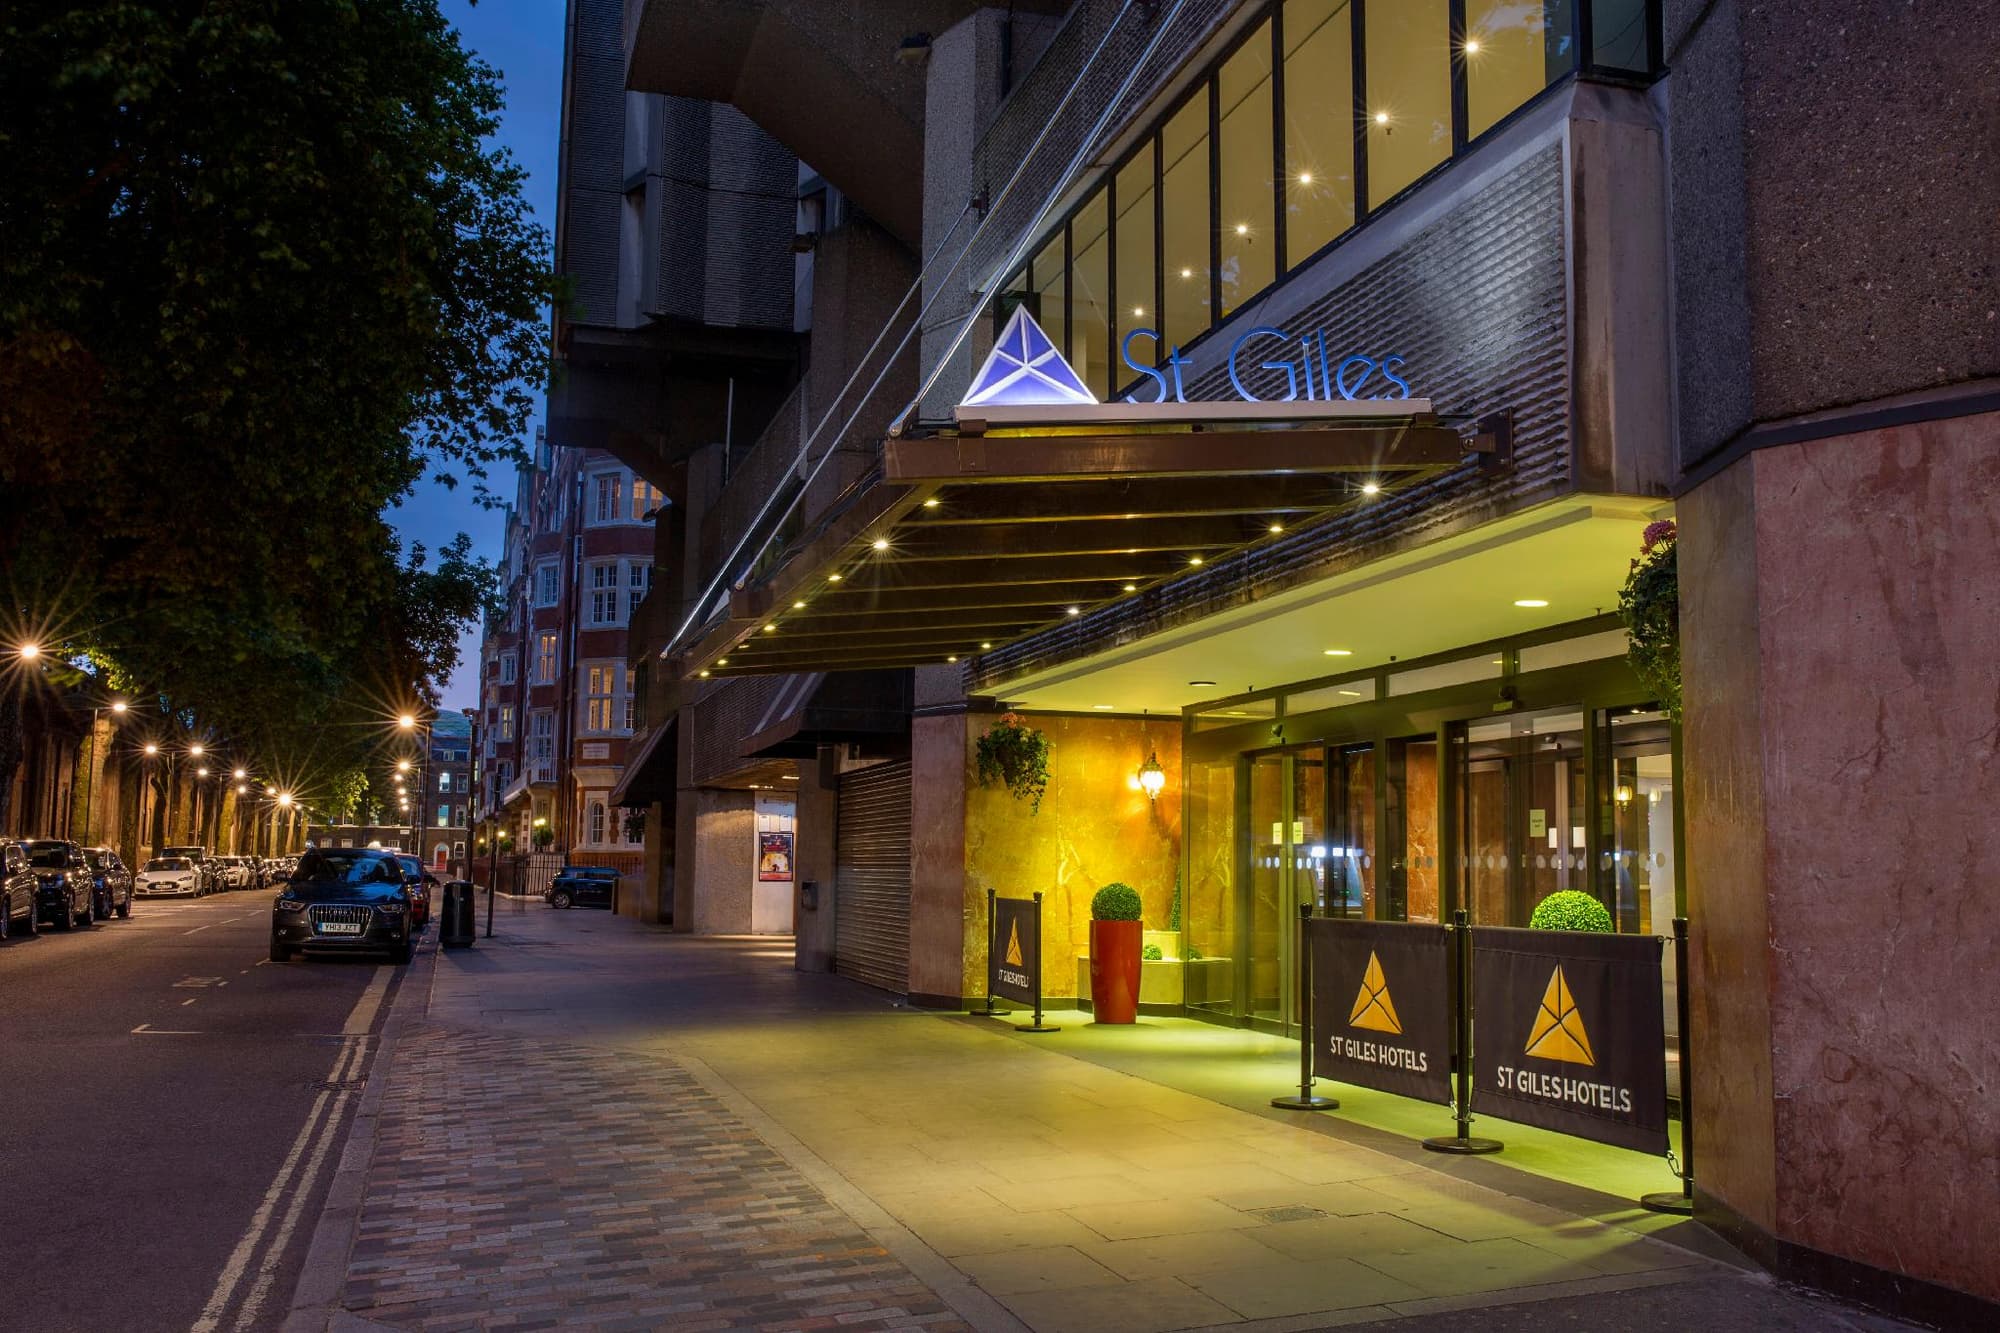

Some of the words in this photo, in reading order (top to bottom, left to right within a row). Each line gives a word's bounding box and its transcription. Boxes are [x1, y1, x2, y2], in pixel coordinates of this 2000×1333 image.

[1123, 328, 1192, 403] St
[1228, 327, 1410, 402] Giles
[1330, 1035, 1344, 1056] ST
[1345, 1038, 1377, 1063] GILES
[1379, 1044, 1428, 1072] HOTELS
[1497, 1065, 1514, 1089] ST
[1517, 1070, 1562, 1099] GILES
[1563, 1078, 1632, 1113] HOTELS
